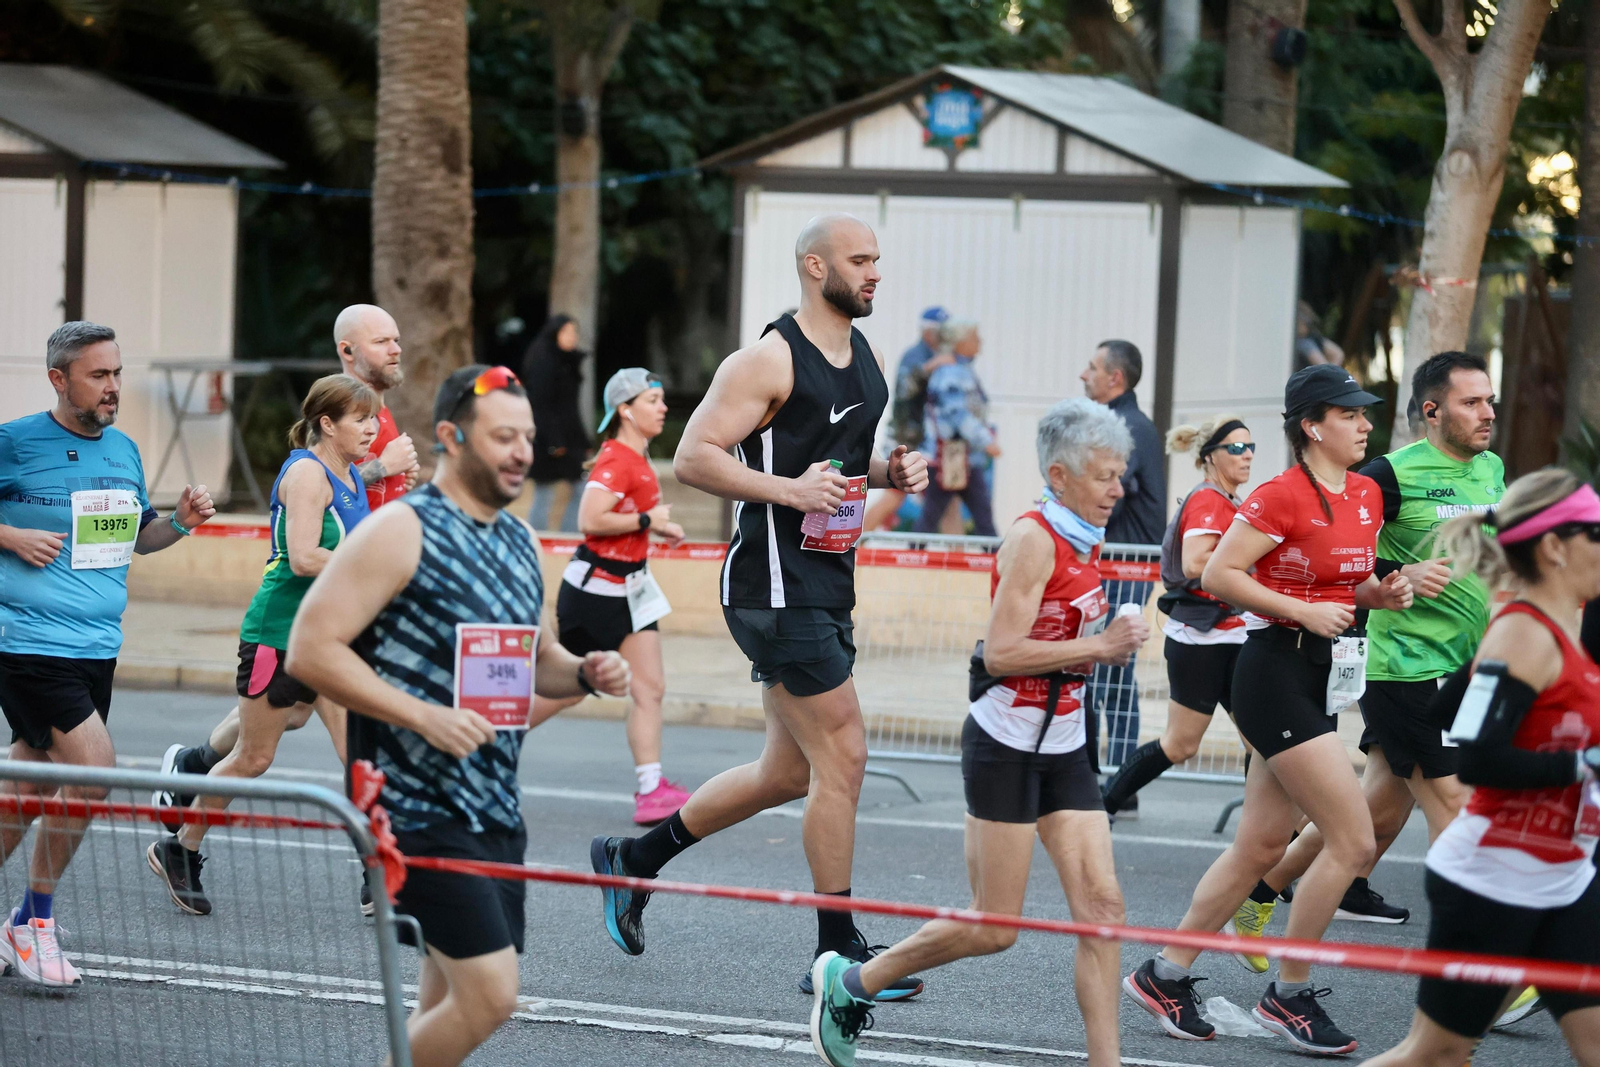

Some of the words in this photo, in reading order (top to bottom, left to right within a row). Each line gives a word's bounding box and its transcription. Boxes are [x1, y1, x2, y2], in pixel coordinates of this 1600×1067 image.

[1426, 488, 1456, 498] HOKA
[93, 518, 128, 531] 13975
[1340, 561, 1366, 573] MÁLAGA
[487, 664, 517, 679] 3496
[1338, 667, 1354, 679] 1473
